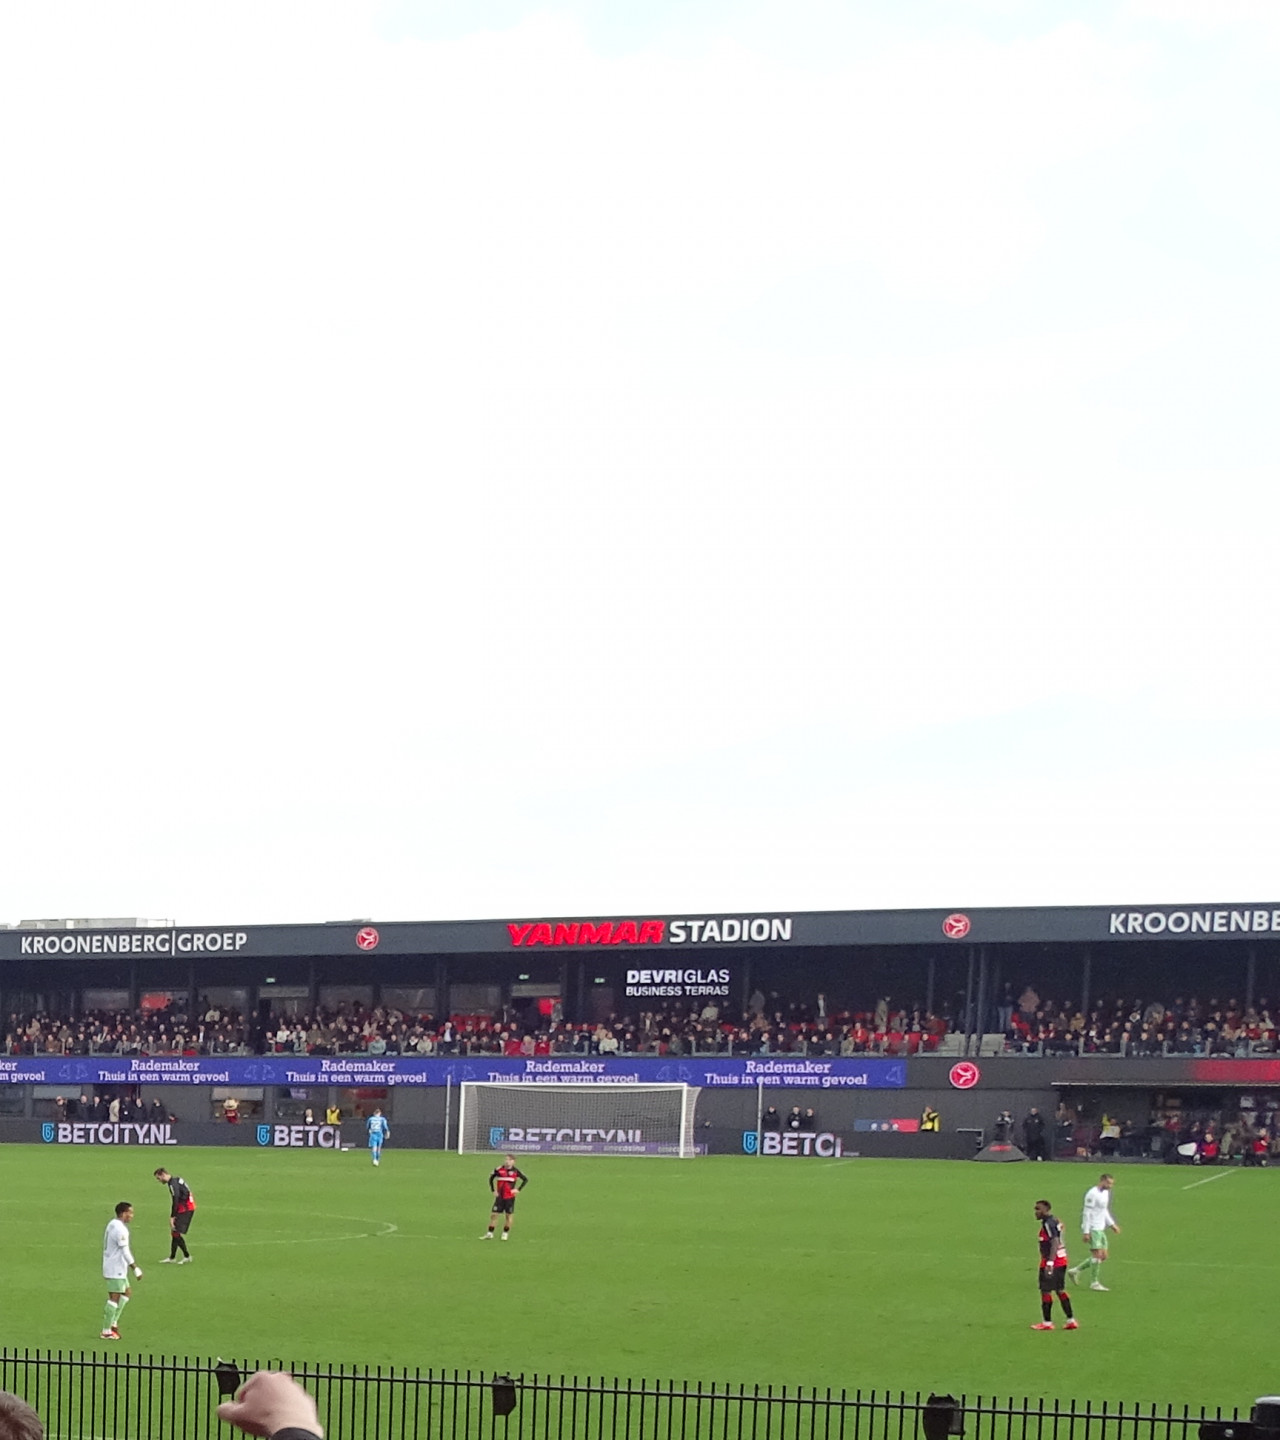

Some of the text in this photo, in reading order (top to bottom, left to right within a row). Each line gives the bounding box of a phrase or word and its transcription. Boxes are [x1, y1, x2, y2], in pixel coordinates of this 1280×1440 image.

[507, 918, 792, 946] YANMAR STADION
[177, 932, 248, 952] GROEP
[626, 969, 730, 984] DEVRIGLAS
[626, 985, 729, 996] BUSINESS TERRAS
[131, 1060, 200, 1071] Rademaker
[321, 1060, 396, 1072] Rademaker
[745, 1061, 832, 1074] Rademaker
[10, 1071, 45, 1083] gevoel
[98, 1071, 229, 1084] Thuis in een warm gevoel
[285, 1071, 427, 1084] Thuis in een warm gevoel
[704, 1073, 739, 1084] Thuis
[741, 1073, 753, 1084] in
[783, 1075, 821, 1084] warm
[822, 1074, 868, 1087] gevoel
[58, 1123, 177, 1144] BETCITY.NL
